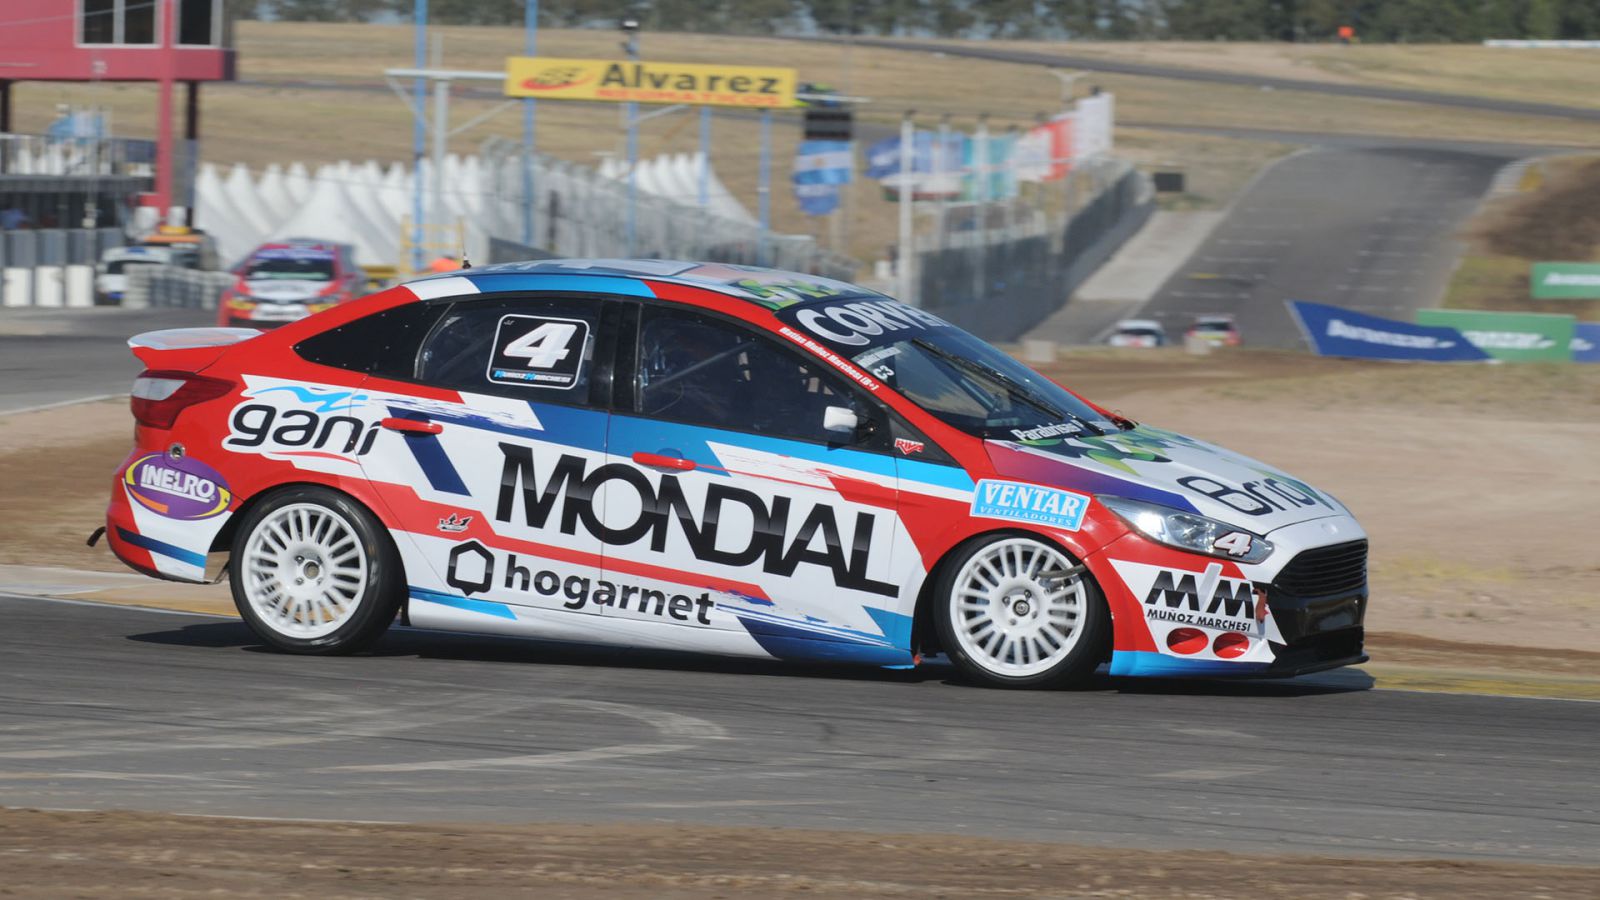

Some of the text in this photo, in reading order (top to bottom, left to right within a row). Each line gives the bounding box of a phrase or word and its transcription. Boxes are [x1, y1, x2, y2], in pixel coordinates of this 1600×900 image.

[601, 63, 779, 94] Alvarez
[503, 322, 577, 368] 4
[227, 404, 382, 456] gani
[141, 464, 215, 499] INELRO
[979, 505, 1074, 527] VENTILADORES
[984, 482, 1081, 518] VENTAR
[496, 442, 899, 598] MONDIAL
[1213, 532, 1251, 557] 4
[504, 554, 714, 625] hogarnet
[1147, 608, 1252, 633] MUÑOZ MARCHESI
